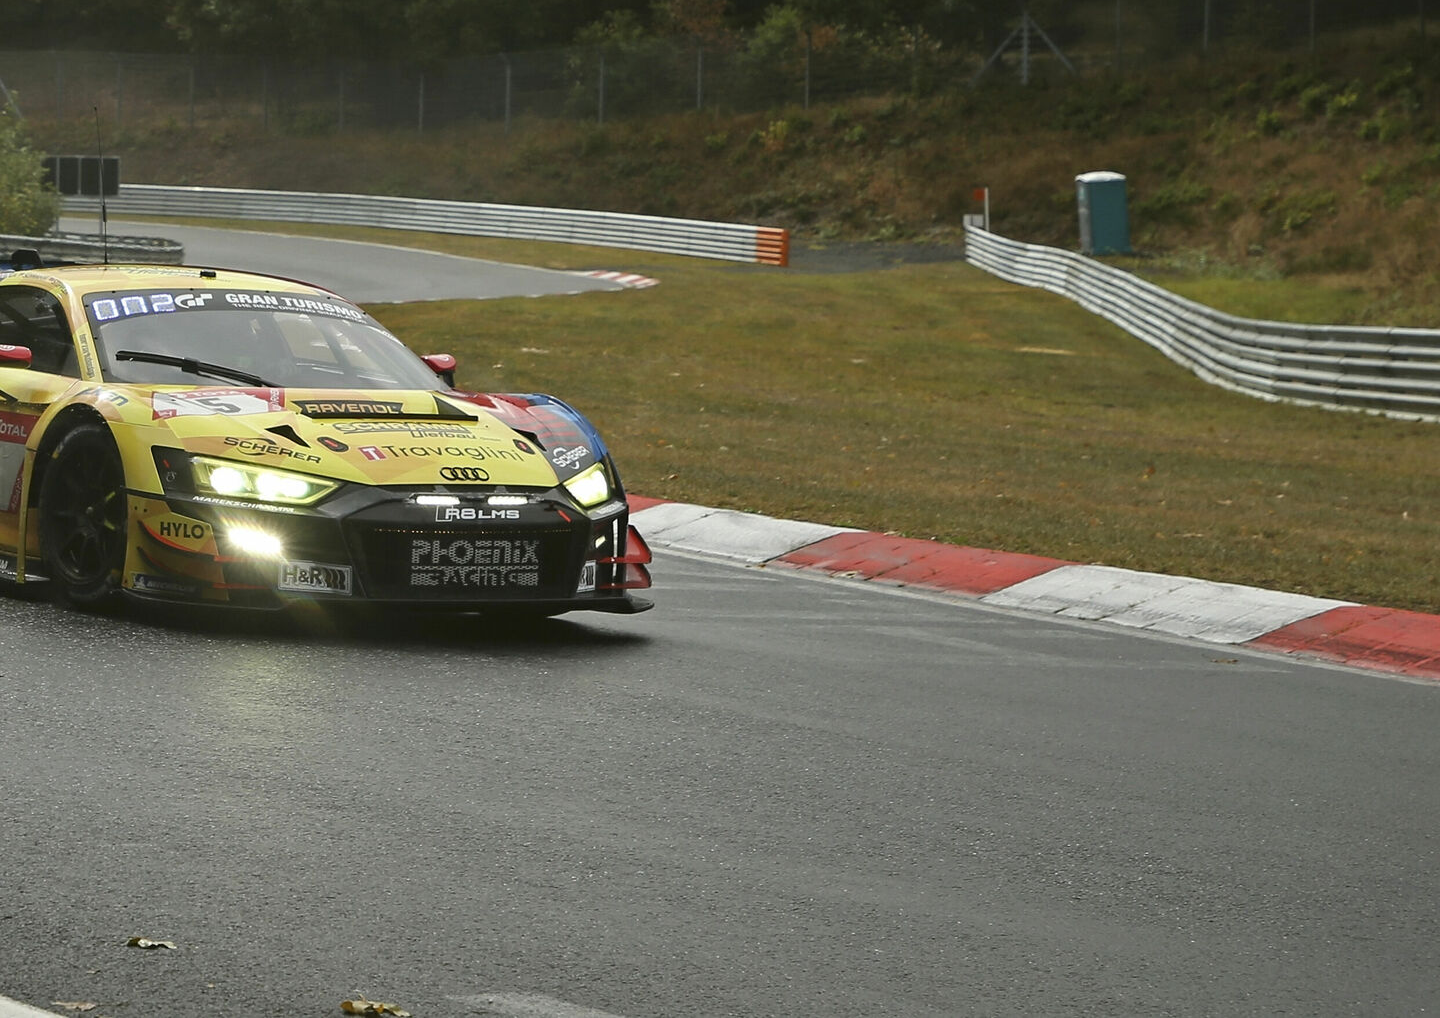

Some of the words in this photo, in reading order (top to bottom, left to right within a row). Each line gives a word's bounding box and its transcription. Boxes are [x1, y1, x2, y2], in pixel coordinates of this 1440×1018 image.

[224, 293, 278, 305] GRAN
[281, 296, 363, 319] TURISMO
[196, 397, 242, 414] 5
[303, 402, 398, 415] RAVENOL
[334, 422, 470, 433] SCHRAMM
[223, 436, 322, 465] SCHERER
[382, 445, 524, 462] Travaglini
[445, 508, 476, 520] R8
[478, 509, 520, 520] LMS
[160, 521, 205, 540] HYLO
[411, 539, 540, 564] PHOENIX
[283, 565, 325, 586] H&R
